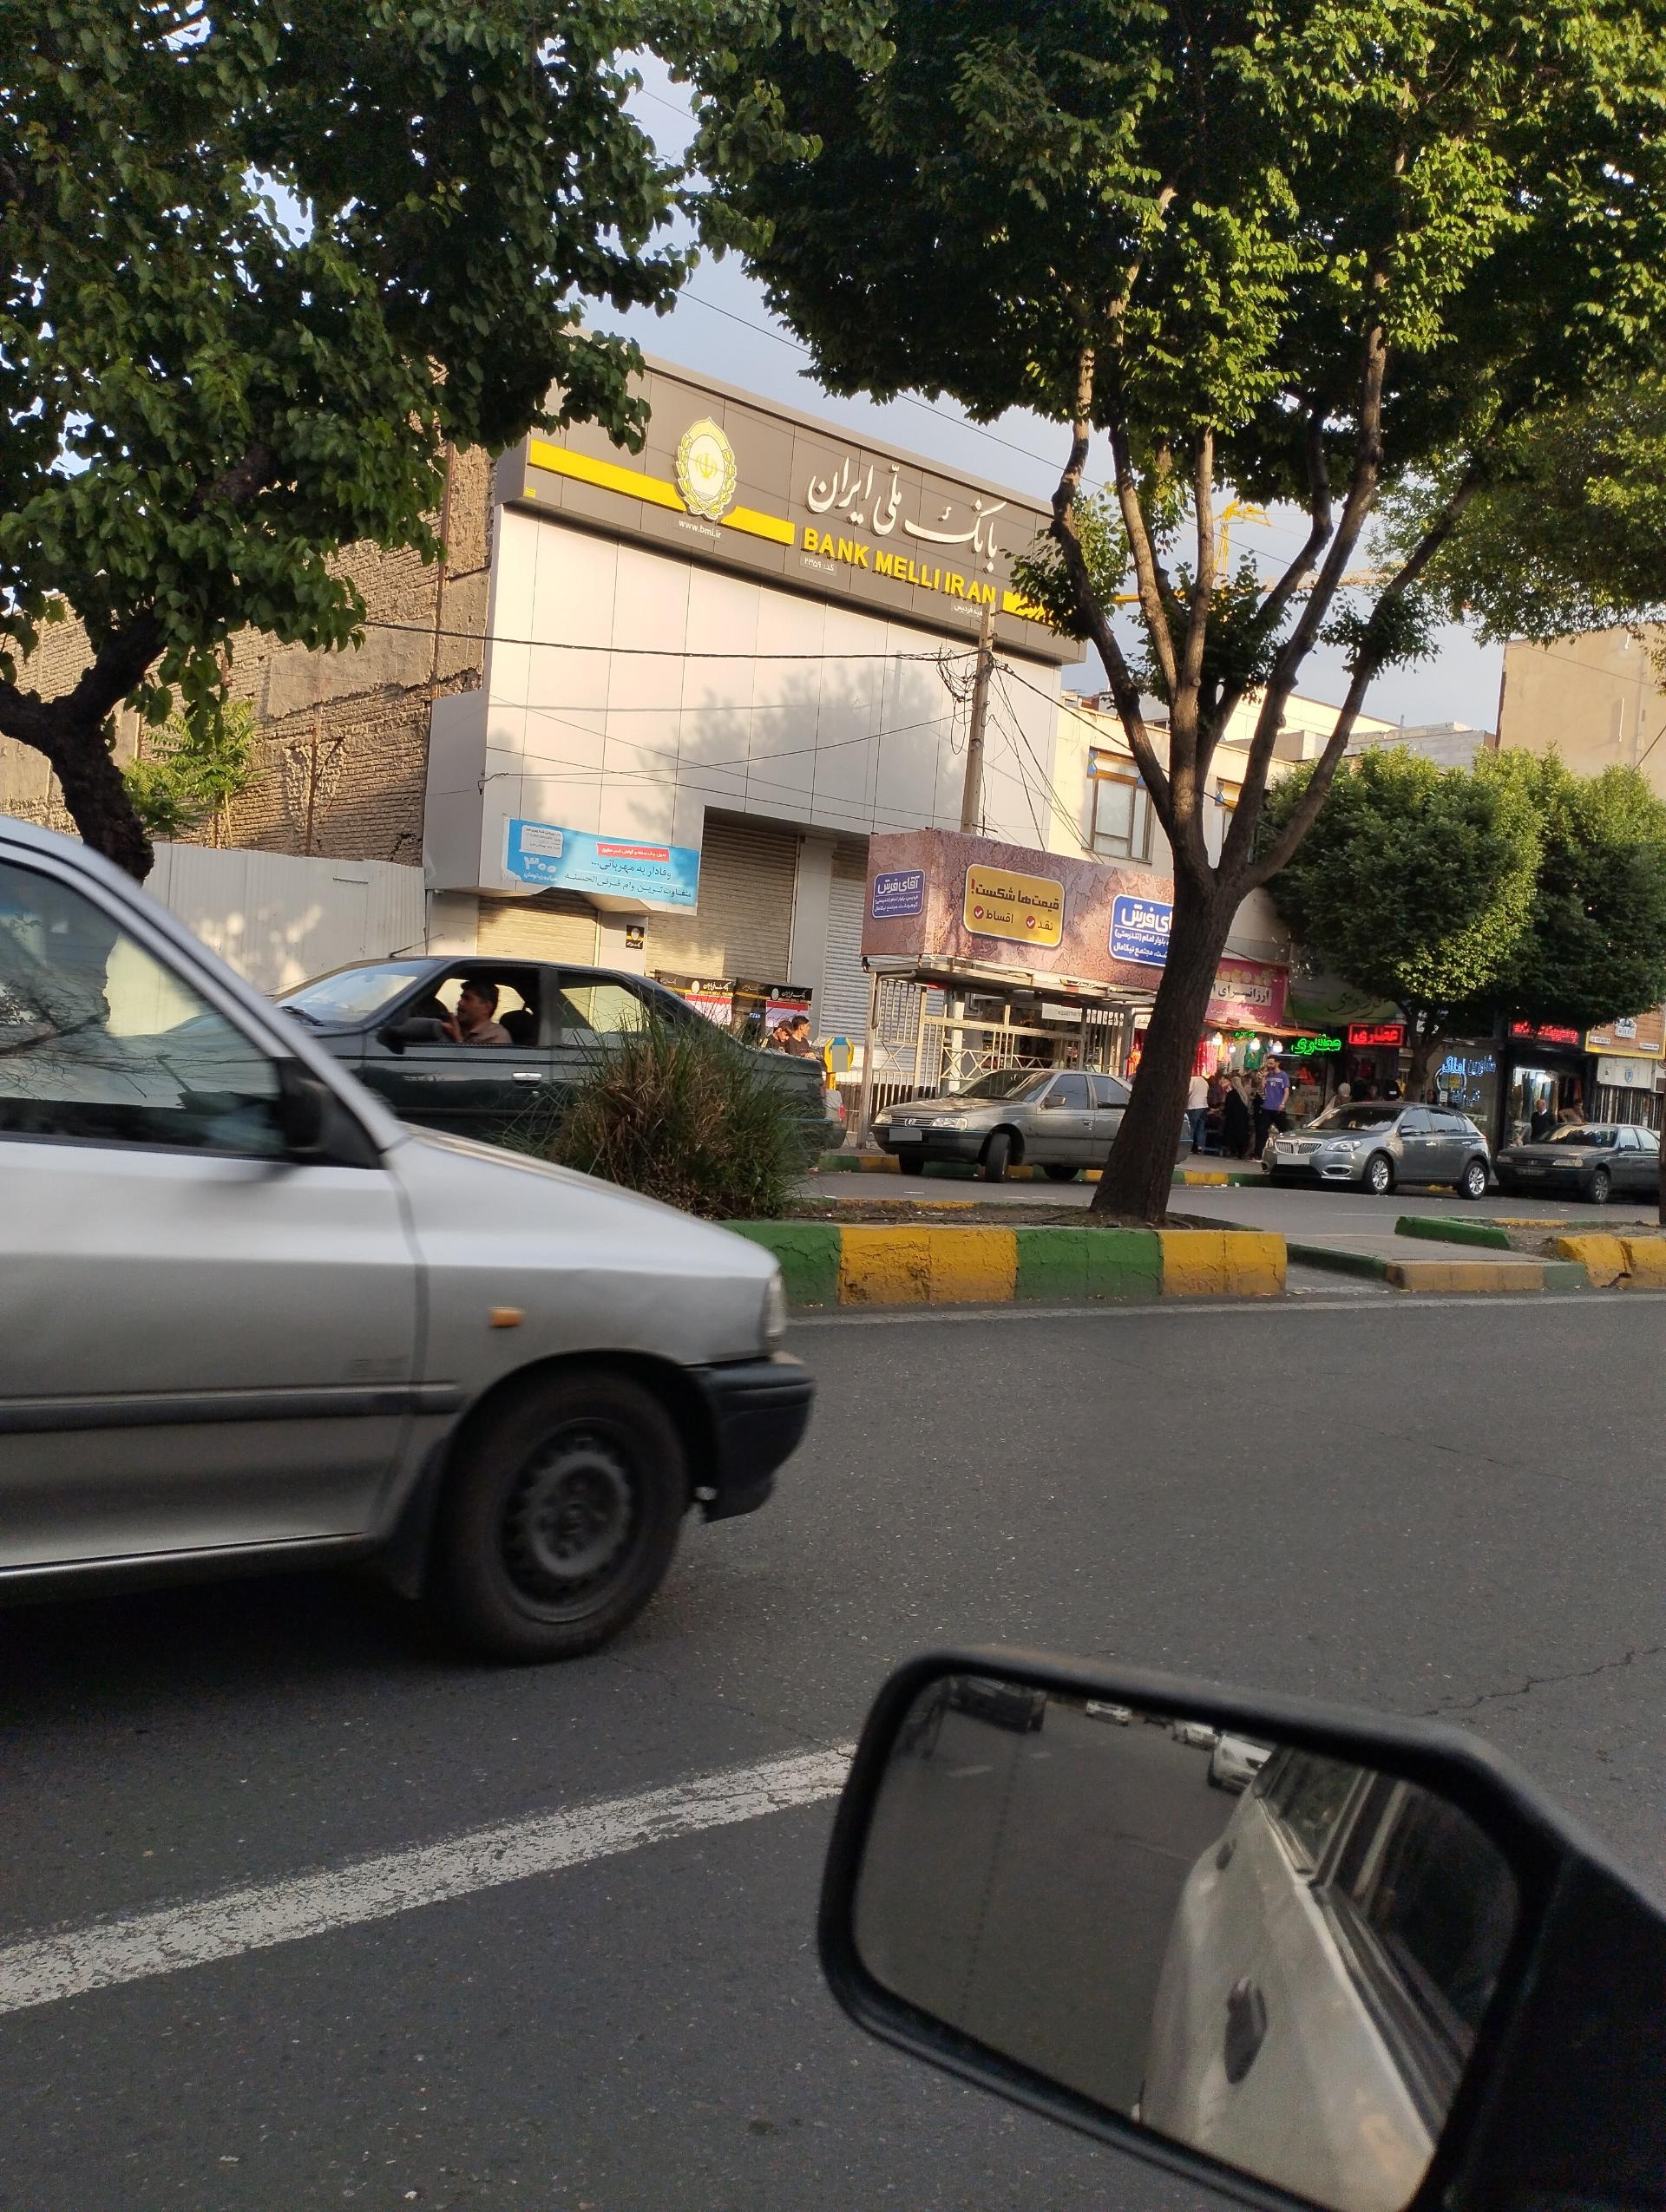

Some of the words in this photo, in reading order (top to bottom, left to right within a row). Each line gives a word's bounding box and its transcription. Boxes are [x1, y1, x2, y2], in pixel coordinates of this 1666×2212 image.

[808, 457, 873, 525] ایران
[679, 520, 722, 539] www.bmi.ir
[902, 500, 1007, 573] بانک
[803, 527, 869, 567] BANK
[875, 550, 940, 590] MELLI
[944, 571, 996, 605] IRAN
[954, 605, 973, 614] فردیس
[523, 856, 556, 873] ۳۰۰
[636, 865, 646, 874] به
[647, 865, 672, 880] وفادار
[622, 880, 635, 892] وام
[877, 878, 899, 894] فرش
[898, 875, 921, 893] آقای
[986, 909, 1013, 924] اقساط
[1121, 903, 1156, 928] فرش
[1037, 920, 1053, 931] نقد
[1141, 933, 1155, 944] امام
[1153, 936, 1166, 947] بلوار
[1134, 947, 1154, 958] مجتمع
[1441, 1056, 1466, 1075] املاک
